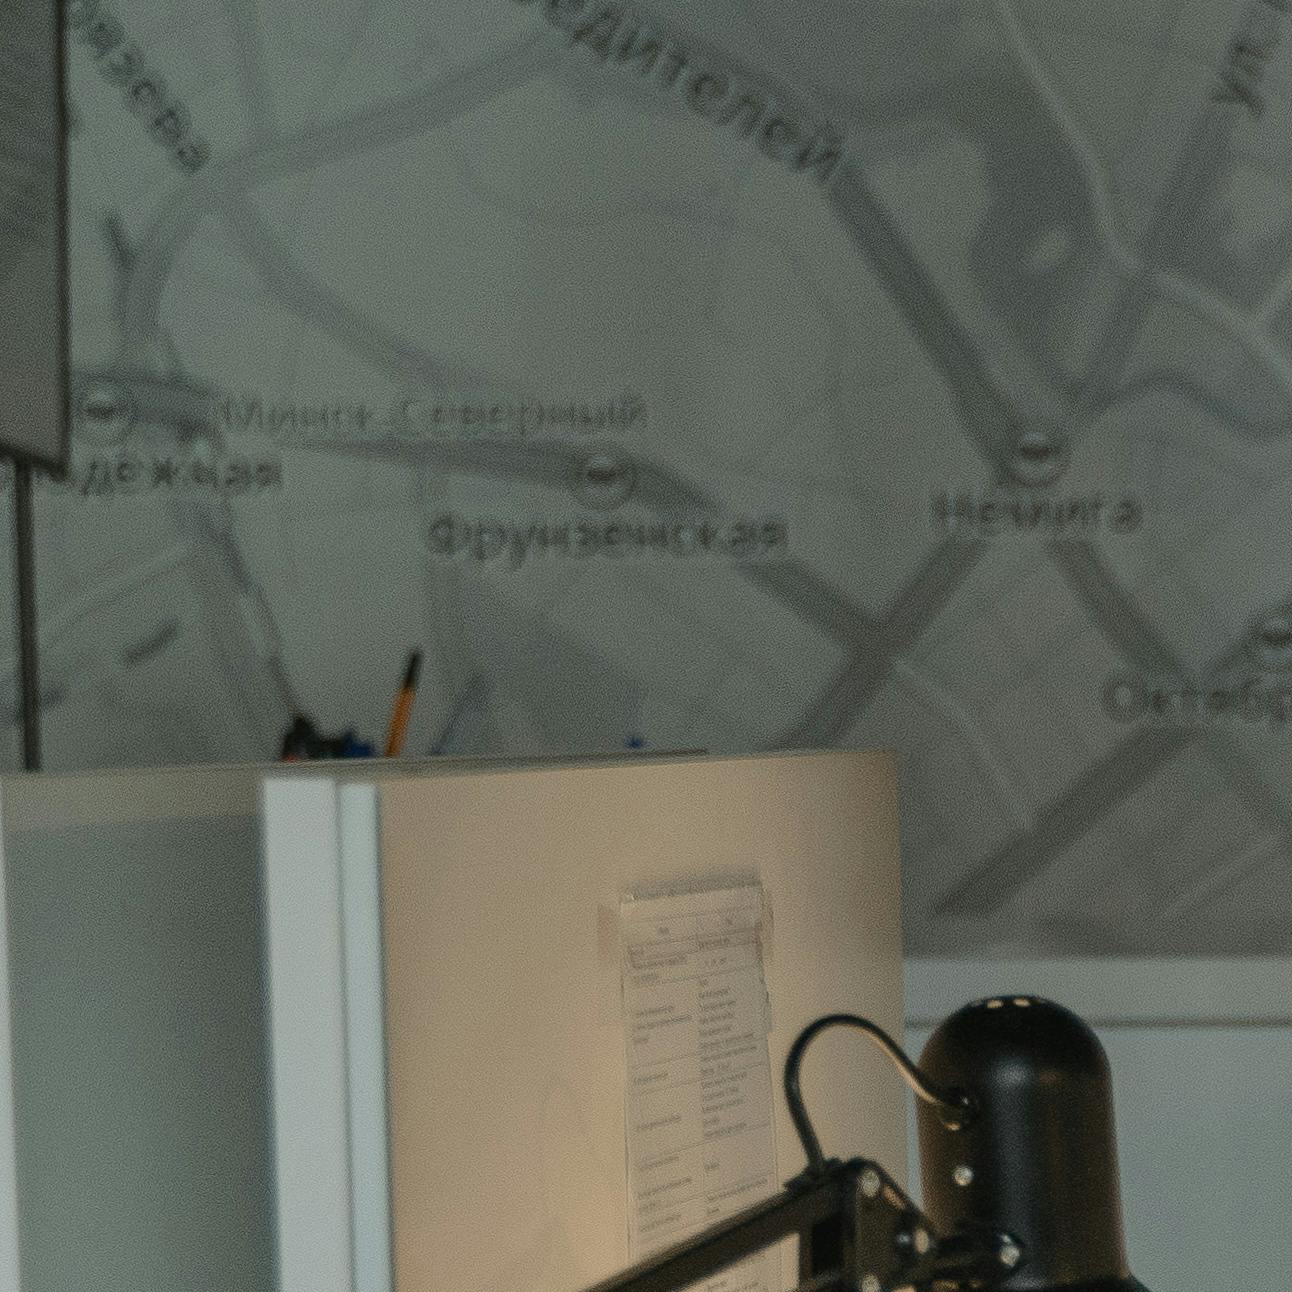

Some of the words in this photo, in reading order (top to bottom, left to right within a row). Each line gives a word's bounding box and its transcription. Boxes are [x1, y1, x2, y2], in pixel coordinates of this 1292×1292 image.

[515, 0, 847, 185] едителей
[427, 513, 787, 566] Фрунзенская
[931, 493, 1142, 535] Немига
